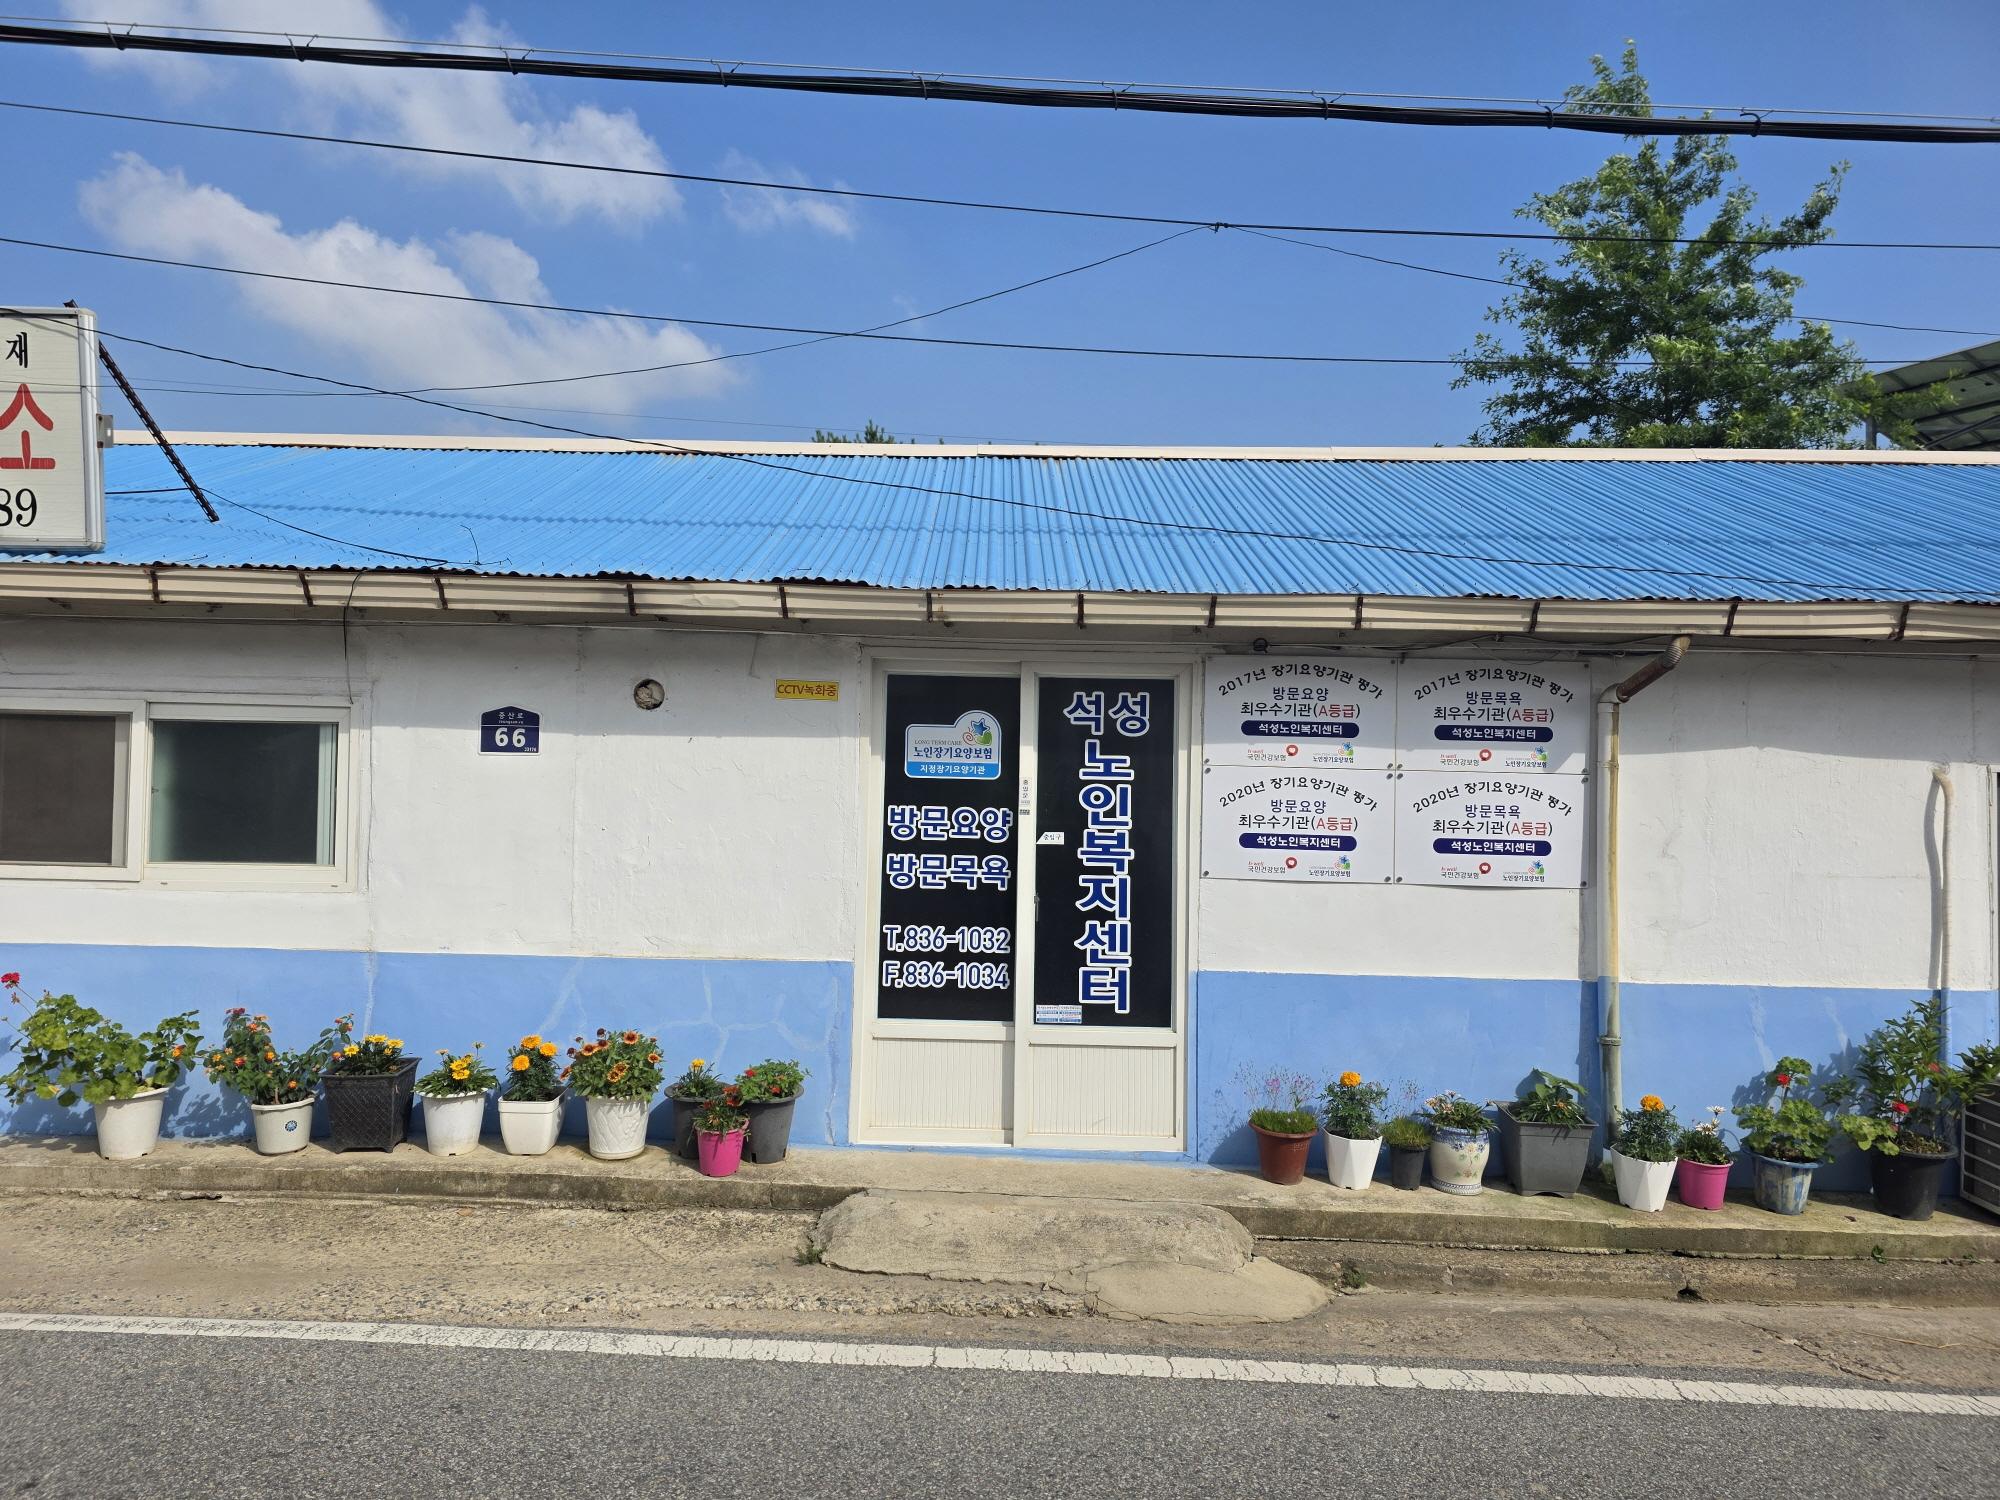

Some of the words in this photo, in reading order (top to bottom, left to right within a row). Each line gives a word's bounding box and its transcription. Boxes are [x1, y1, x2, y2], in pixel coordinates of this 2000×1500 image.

[6, 332, 28, 368] 재
[0, 383, 56, 469] 소
[1218, 670, 1267, 696] 2017년
[1272, 663, 1353, 685] 장기요양기관
[1358, 677, 1383, 700] 평가
[1414, 672, 1461, 700] 2017년
[1465, 668, 1545, 688] 장기요양기관
[1549, 681, 1576, 703] 평가
[777, 684, 837, 697] CCTV녹화중
[1273, 686, 1329, 702] 방문요양
[1466, 691, 1522, 706] 방문목욕
[1063, 691, 1150, 737] 석성
[1241, 702, 1361, 719] 최우수기관(A등급)
[1433, 706, 1554, 723] 최우수기관(A등급)
[495, 727, 526, 748] 66
[1258, 723, 1343, 735] 석성노인복지센터
[1451, 727, 1536, 740] 석성노인복지센터
[913, 746, 992, 760] 노인장기요양보험
[920, 764, 986, 775] 지정장기요양기관
[1219, 780, 1266, 807] 2020년
[1270, 776, 1350, 797] 장기요양기관
[1353, 790, 1378, 812] 평가
[1413, 785, 1460, 813] 2020년
[1464, 781, 1544, 802] 장기요양기관
[1547, 795, 1573, 817] 평가
[1270, 799, 1327, 815] 방문요양
[1465, 804, 1521, 819] 방문목욕
[888, 805, 1013, 843] 방문요양
[1238, 814, 1358, 832] 최우수기관(A등급)
[1432, 819, 1553, 836] 최우수기관(A등급)
[1256, 835, 1341, 848] 석성노인복지센터
[1451, 840, 1536, 853] 석성노인복지센터
[886, 853, 1011, 890] 방문목욕
[1074, 738, 1135, 1014] 노인복지센터
[883, 925, 1011, 953] T.836-1032
[882, 960, 1010, 989] F.836-1034
